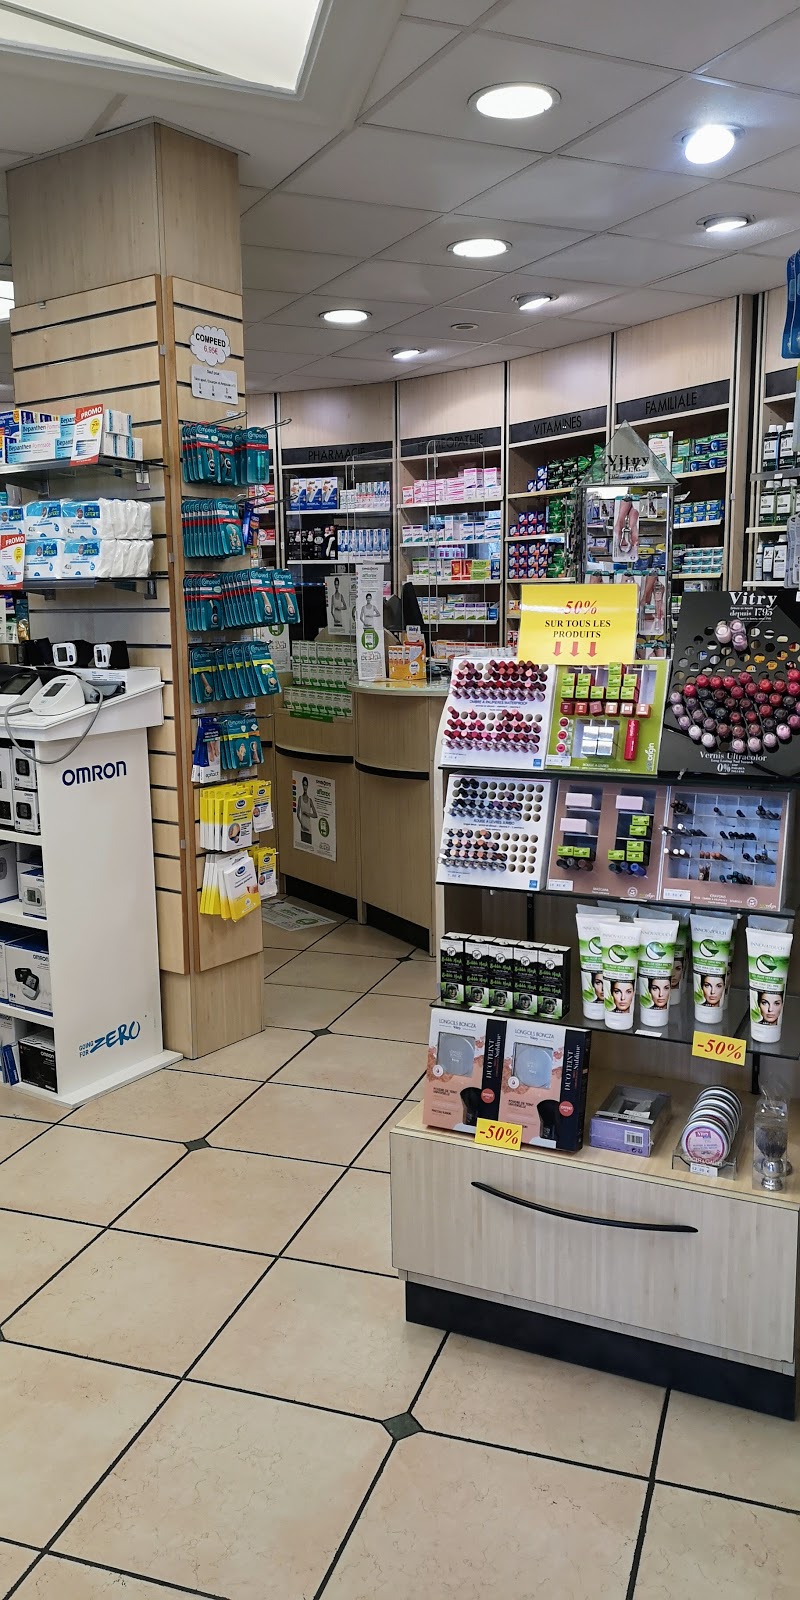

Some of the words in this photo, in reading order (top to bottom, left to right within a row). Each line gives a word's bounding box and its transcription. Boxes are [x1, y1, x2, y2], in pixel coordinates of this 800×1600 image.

[195, 333, 226, 347] COMPEED
[645, 392, 698, 415] FAMILIALE
[80, 406, 102, 420] PROMO
[534, 415, 582, 435] VITAMINES
[9, 443, 31, 452] Bepanthen
[308, 447, 366, 461] PHARMACIE
[5, 536, 25, 545] PROMO
[728, 591, 778, 608] Vitry
[730, 609, 752, 620] depuis
[754, 608, 773, 617] 1795
[545, 620, 564, 628] SUR
[566, 620, 591, 628] TOUS
[593, 620, 611, 628] LES
[553, 630, 601, 639] PRODUITS
[700, 751, 724, 760] Vernis
[726, 752, 768, 762] Ultracolor
[717, 763, 731, 773] 0%
[90, 1020, 141, 1054] ZERO
[79, 1040, 94, 1051] GOING
[697, 1039, 743, 1061] -50%
[79, 1049, 90, 1058] FOR
[480, 1124, 519, 1145] -50%
